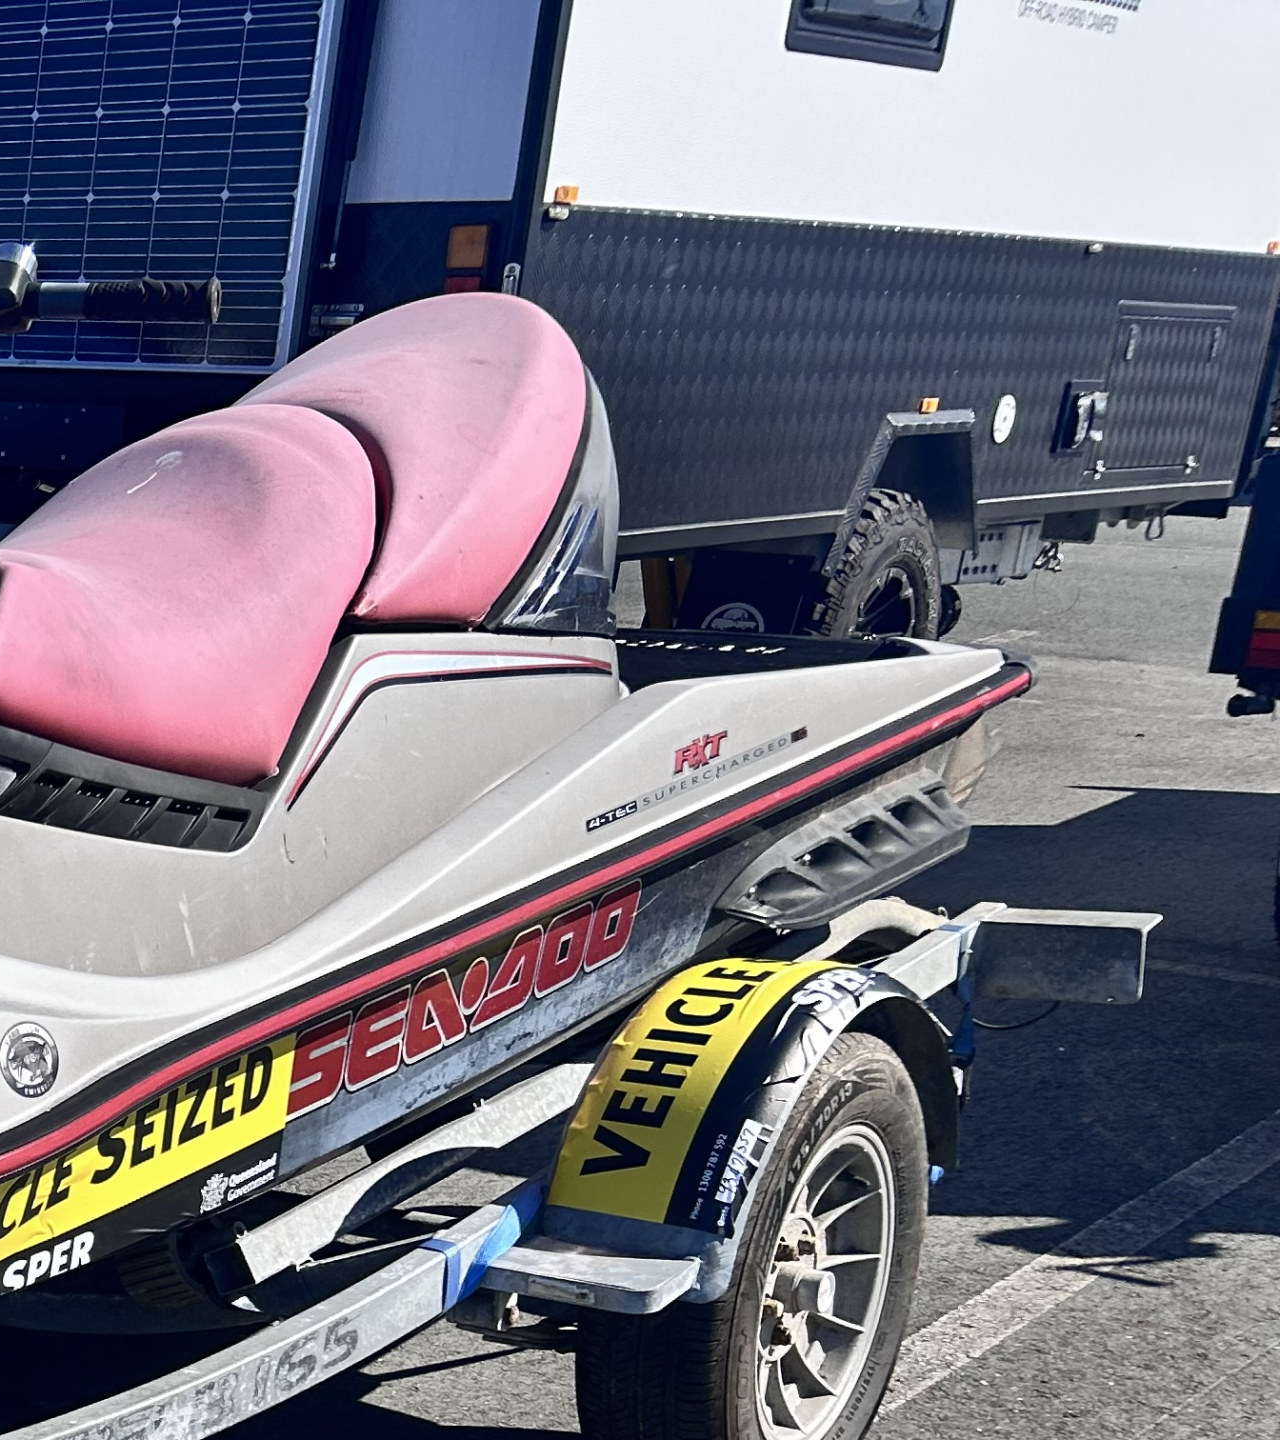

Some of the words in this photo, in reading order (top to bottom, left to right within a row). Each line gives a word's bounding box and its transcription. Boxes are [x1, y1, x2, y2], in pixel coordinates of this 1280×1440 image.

[642, 737, 786, 807] SUPERCHARGED
[673, 730, 728, 776] RXT
[579, 967, 777, 1176] VEHICLE
[92, 1045, 274, 1184] SEIZED
[698, 1169, 713, 1192] 1300
[706, 1151, 720, 1167] 787
[714, 1133, 728, 1150] 592
[1, 1230, 95, 1294] SPER
